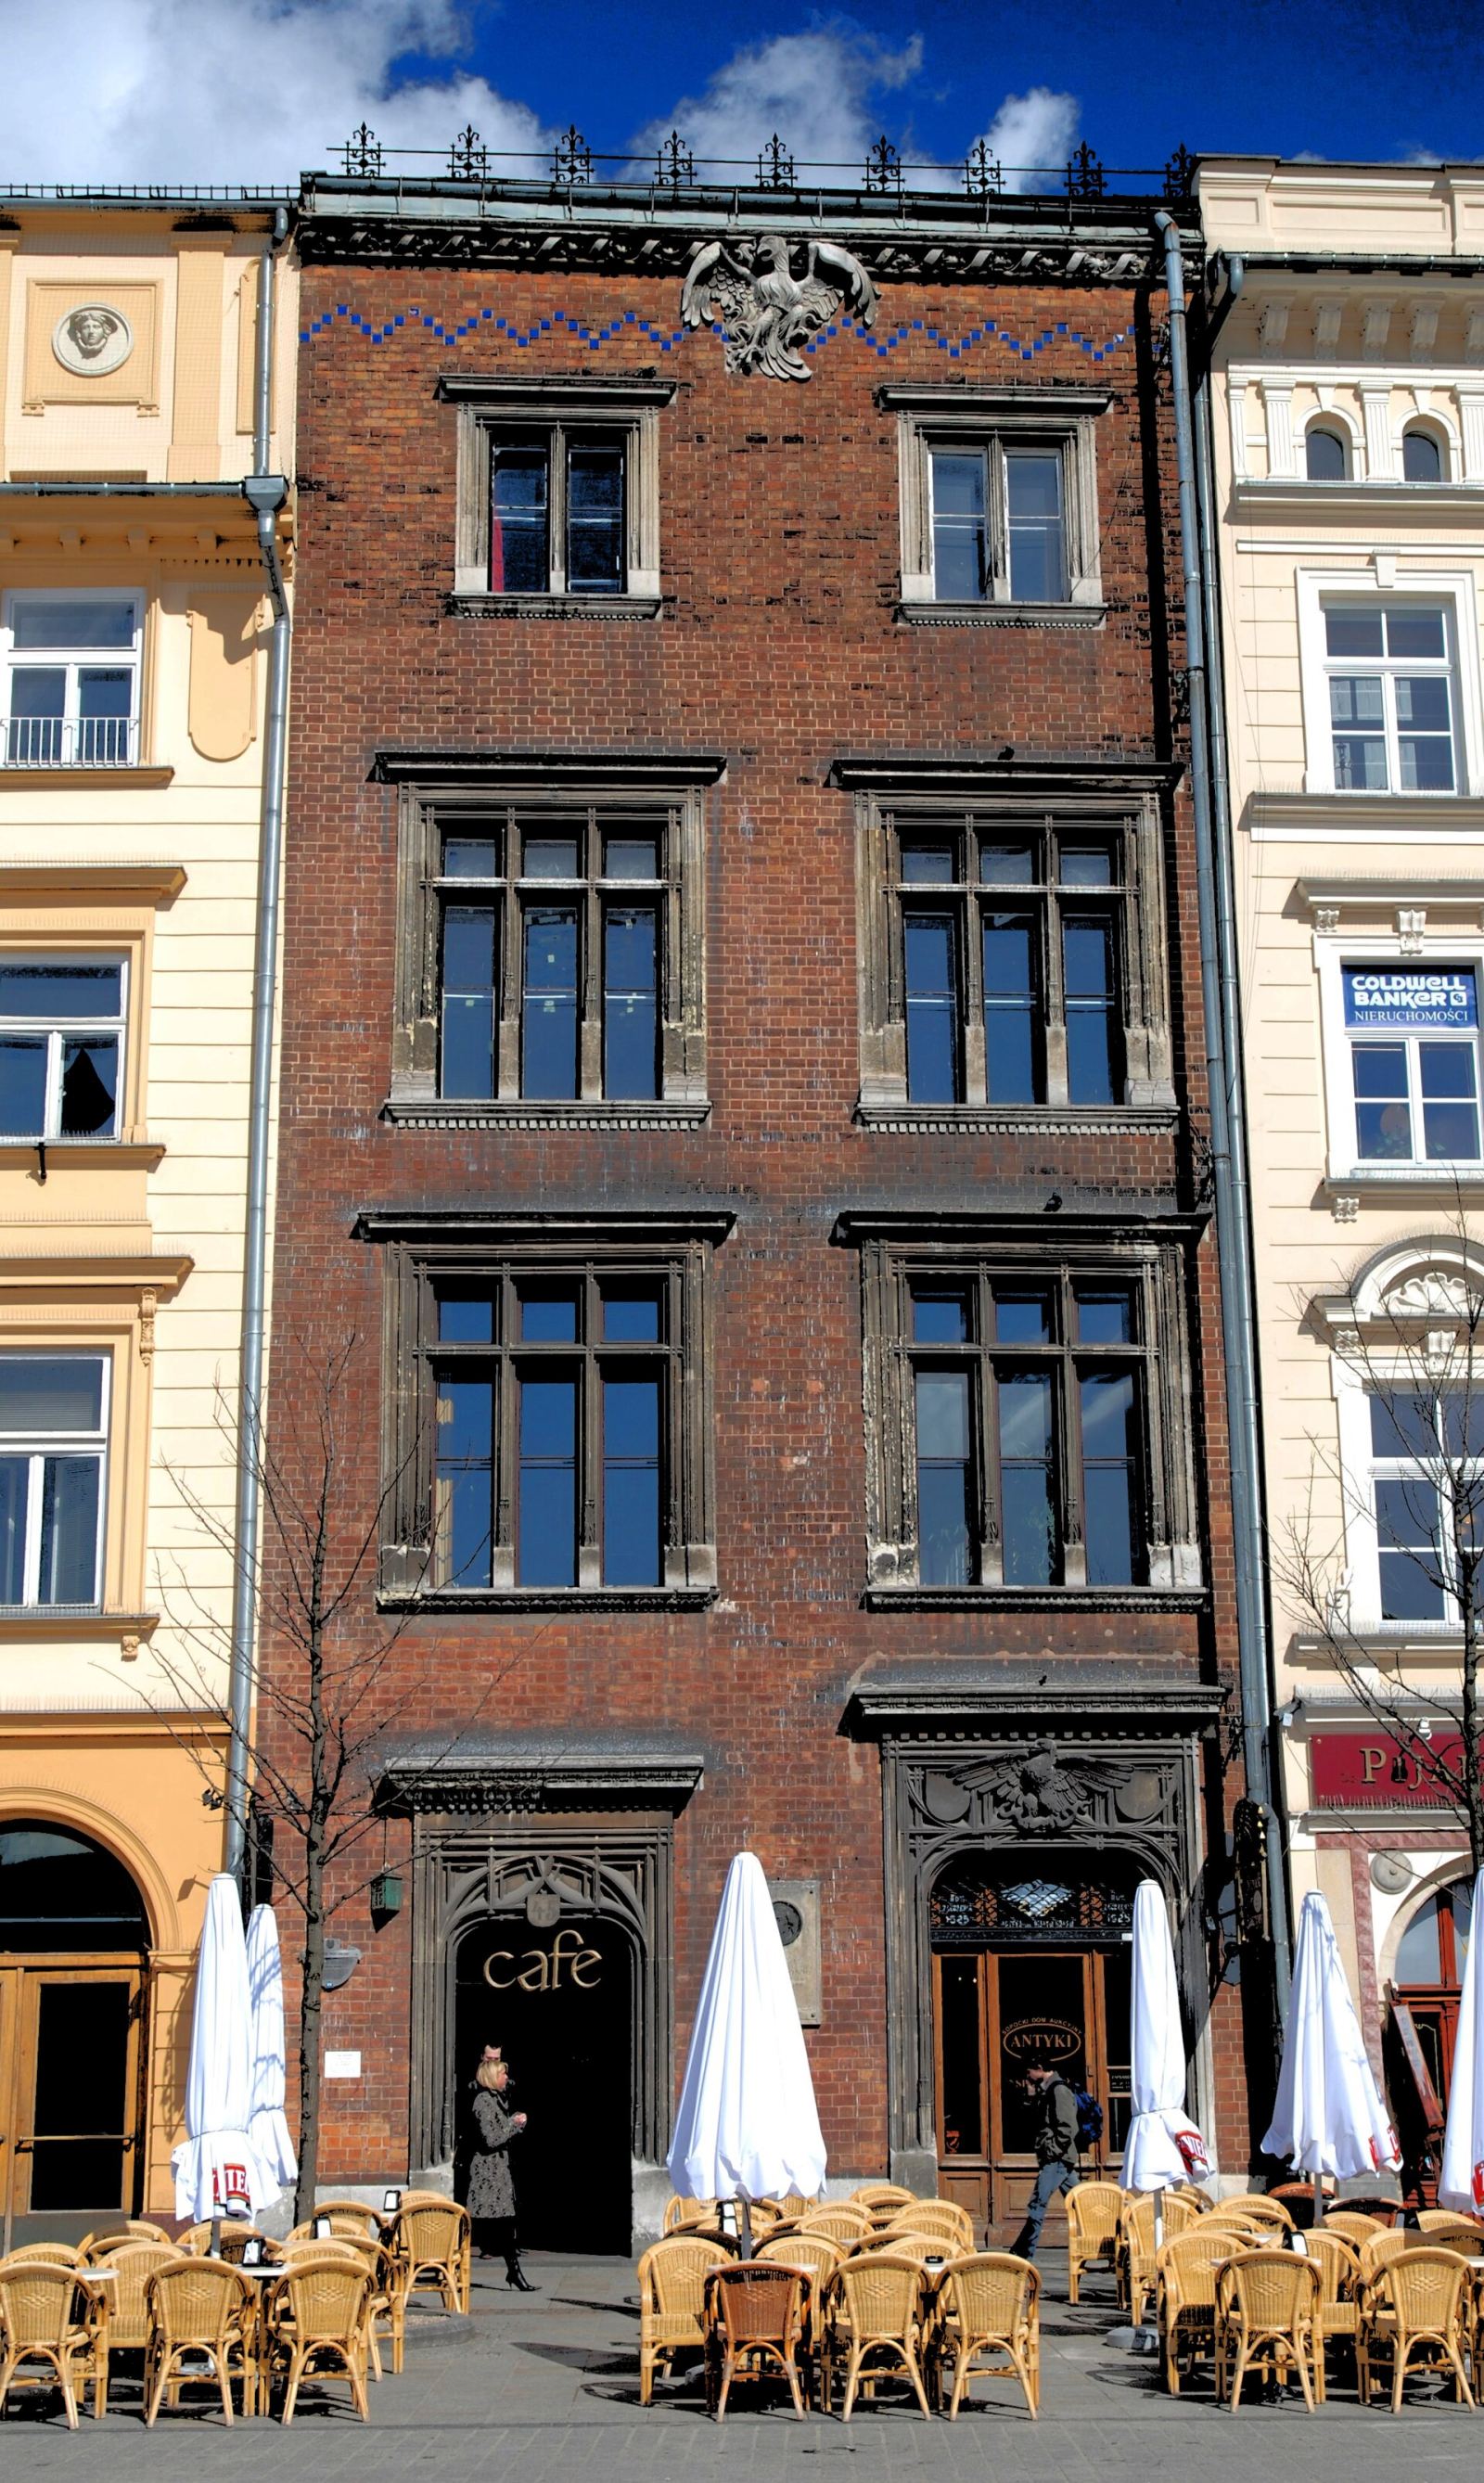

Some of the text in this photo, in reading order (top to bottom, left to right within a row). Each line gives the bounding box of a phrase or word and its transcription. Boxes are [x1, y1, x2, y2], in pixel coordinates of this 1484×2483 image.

[1351, 976, 1466, 991] COLDWELL
[1354, 991, 1448, 1009] BANKER
[1354, 1007, 1468, 1021] NIERUCHOMOŚCI
[483, 1929, 603, 1992] cafe
[1010, 2034, 1071, 2048] ANTYKI
